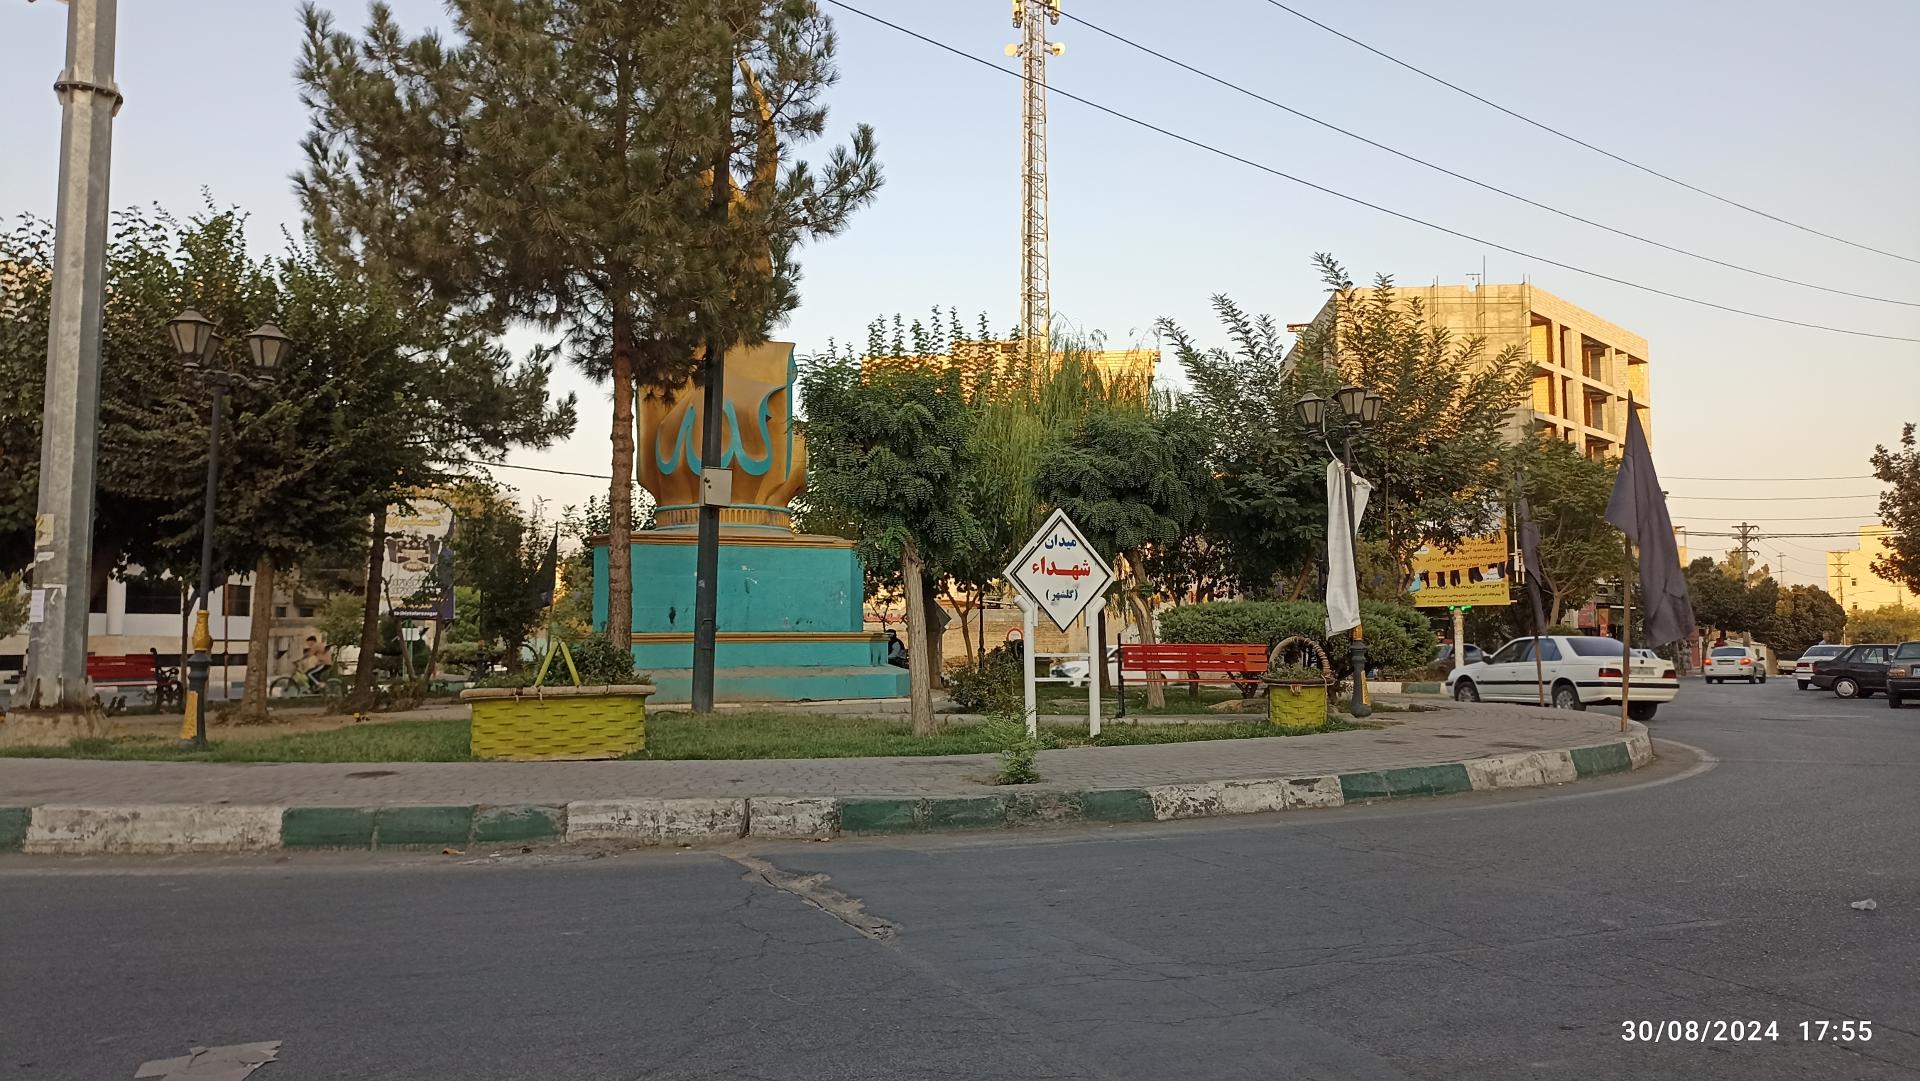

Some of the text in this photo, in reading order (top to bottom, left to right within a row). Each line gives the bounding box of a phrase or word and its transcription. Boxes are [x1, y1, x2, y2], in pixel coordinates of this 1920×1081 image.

[1044, 533, 1077, 550] میدان
[1031, 555, 1091, 581] شهداء
[1045, 589, 1078, 601] (گلشهر)
